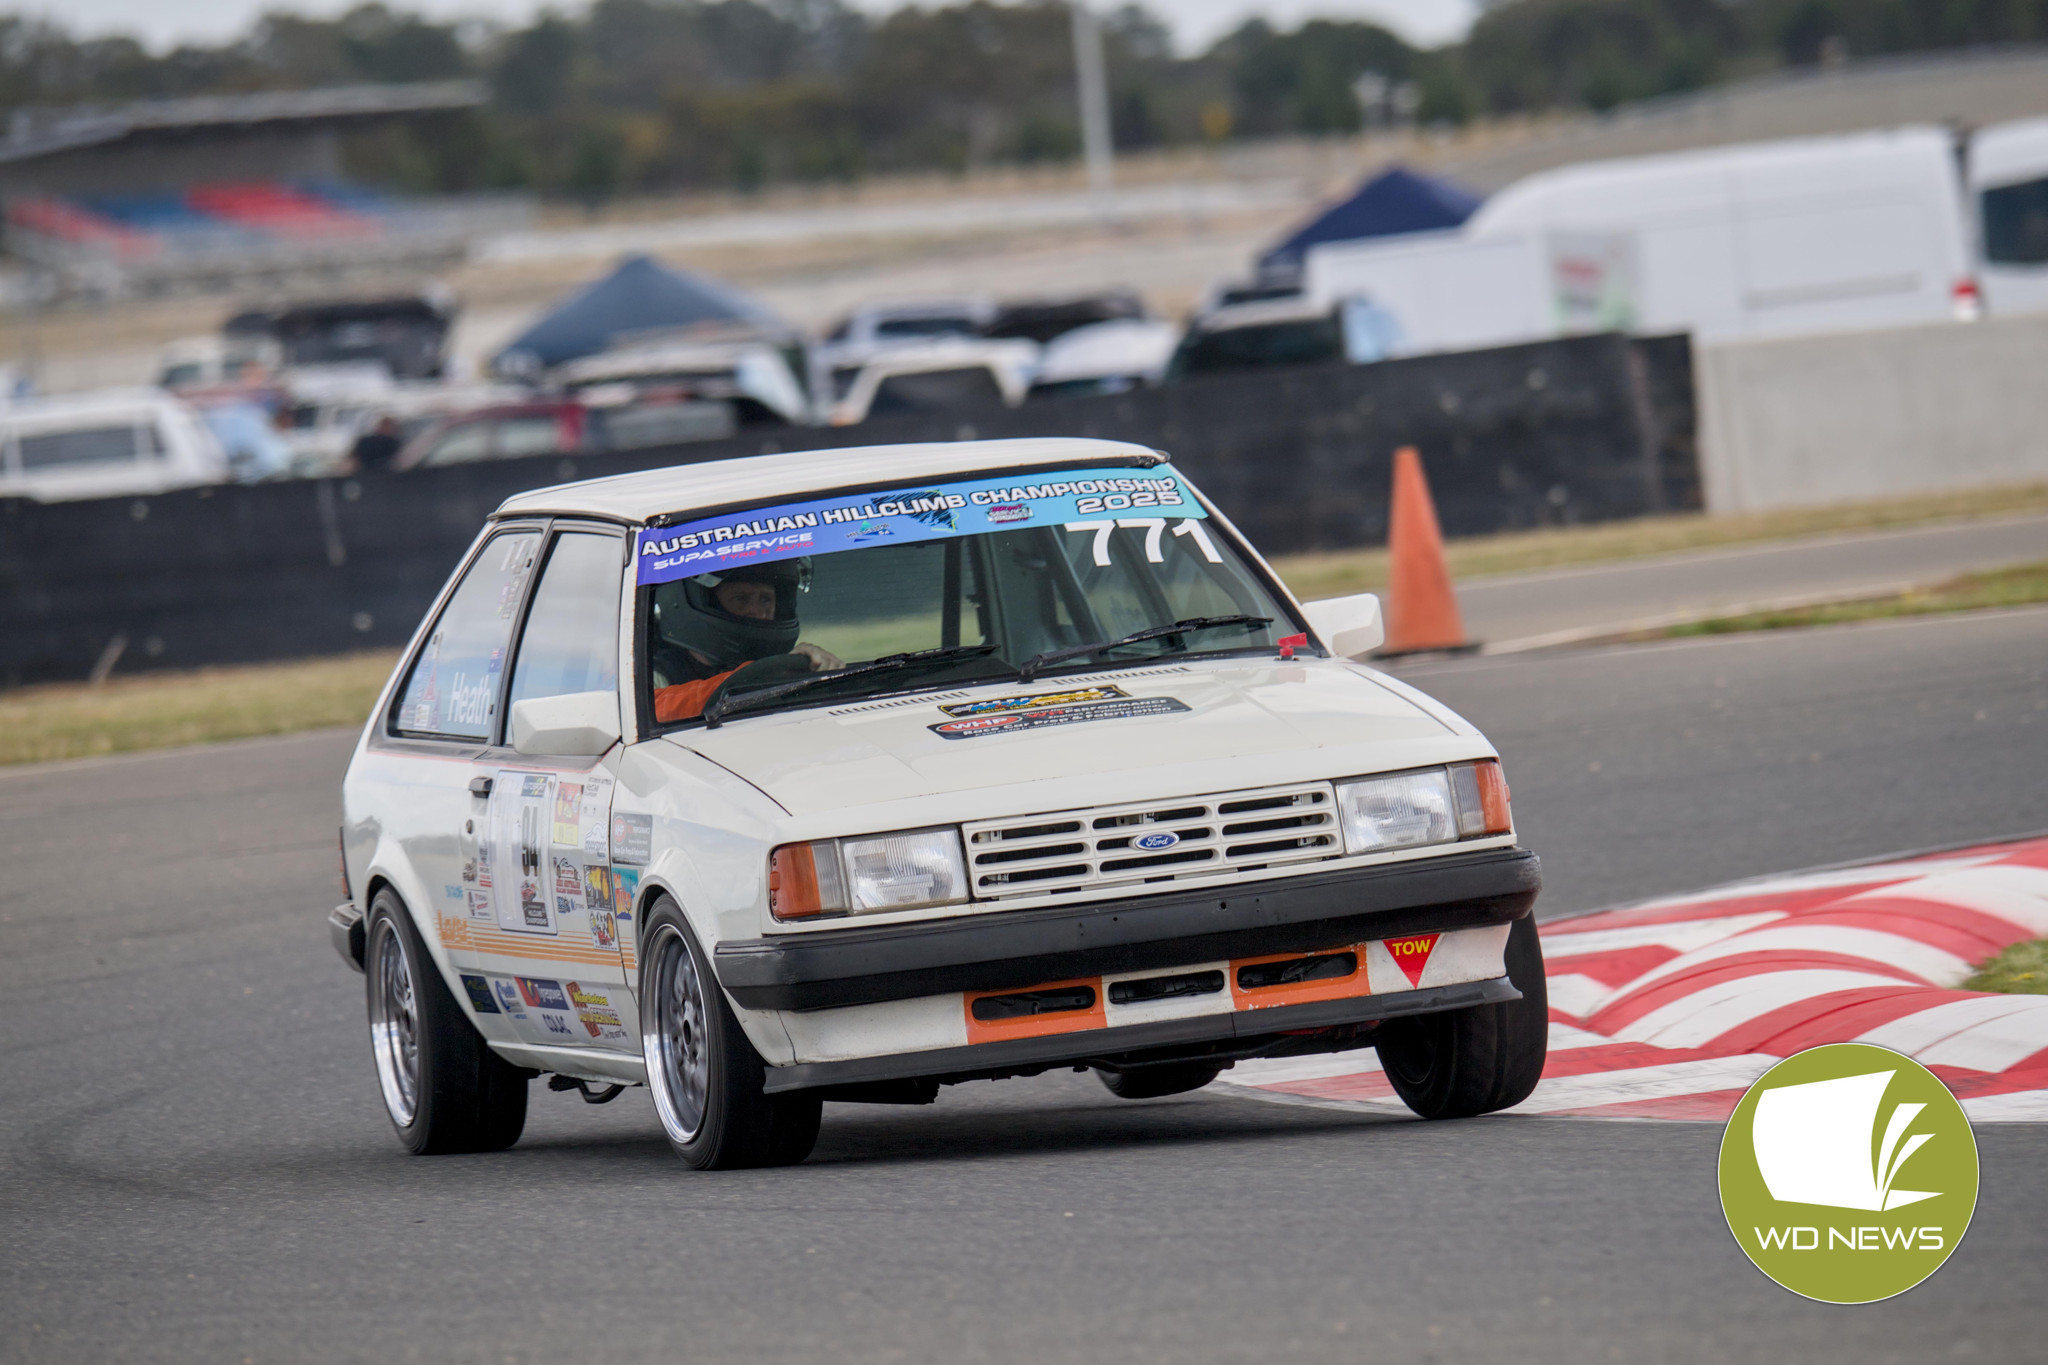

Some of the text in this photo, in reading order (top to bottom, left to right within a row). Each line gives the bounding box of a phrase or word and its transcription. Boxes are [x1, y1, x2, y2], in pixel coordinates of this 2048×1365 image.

[1076, 490, 1184, 515] 2025
[641, 476, 1177, 557] AUSTRALIAN HILLCLIMB CHAMPIONSHIP
[653, 532, 813, 570] SUPASERVICE
[721, 551, 757, 562] TYRE
[775, 541, 815, 553] AUTO
[1064, 518, 1224, 567] 771
[447, 671, 491, 726] Heath
[950, 717, 1009, 731] WHP
[1146, 835, 1169, 846] Ford
[1392, 939, 1431, 956] TOW
